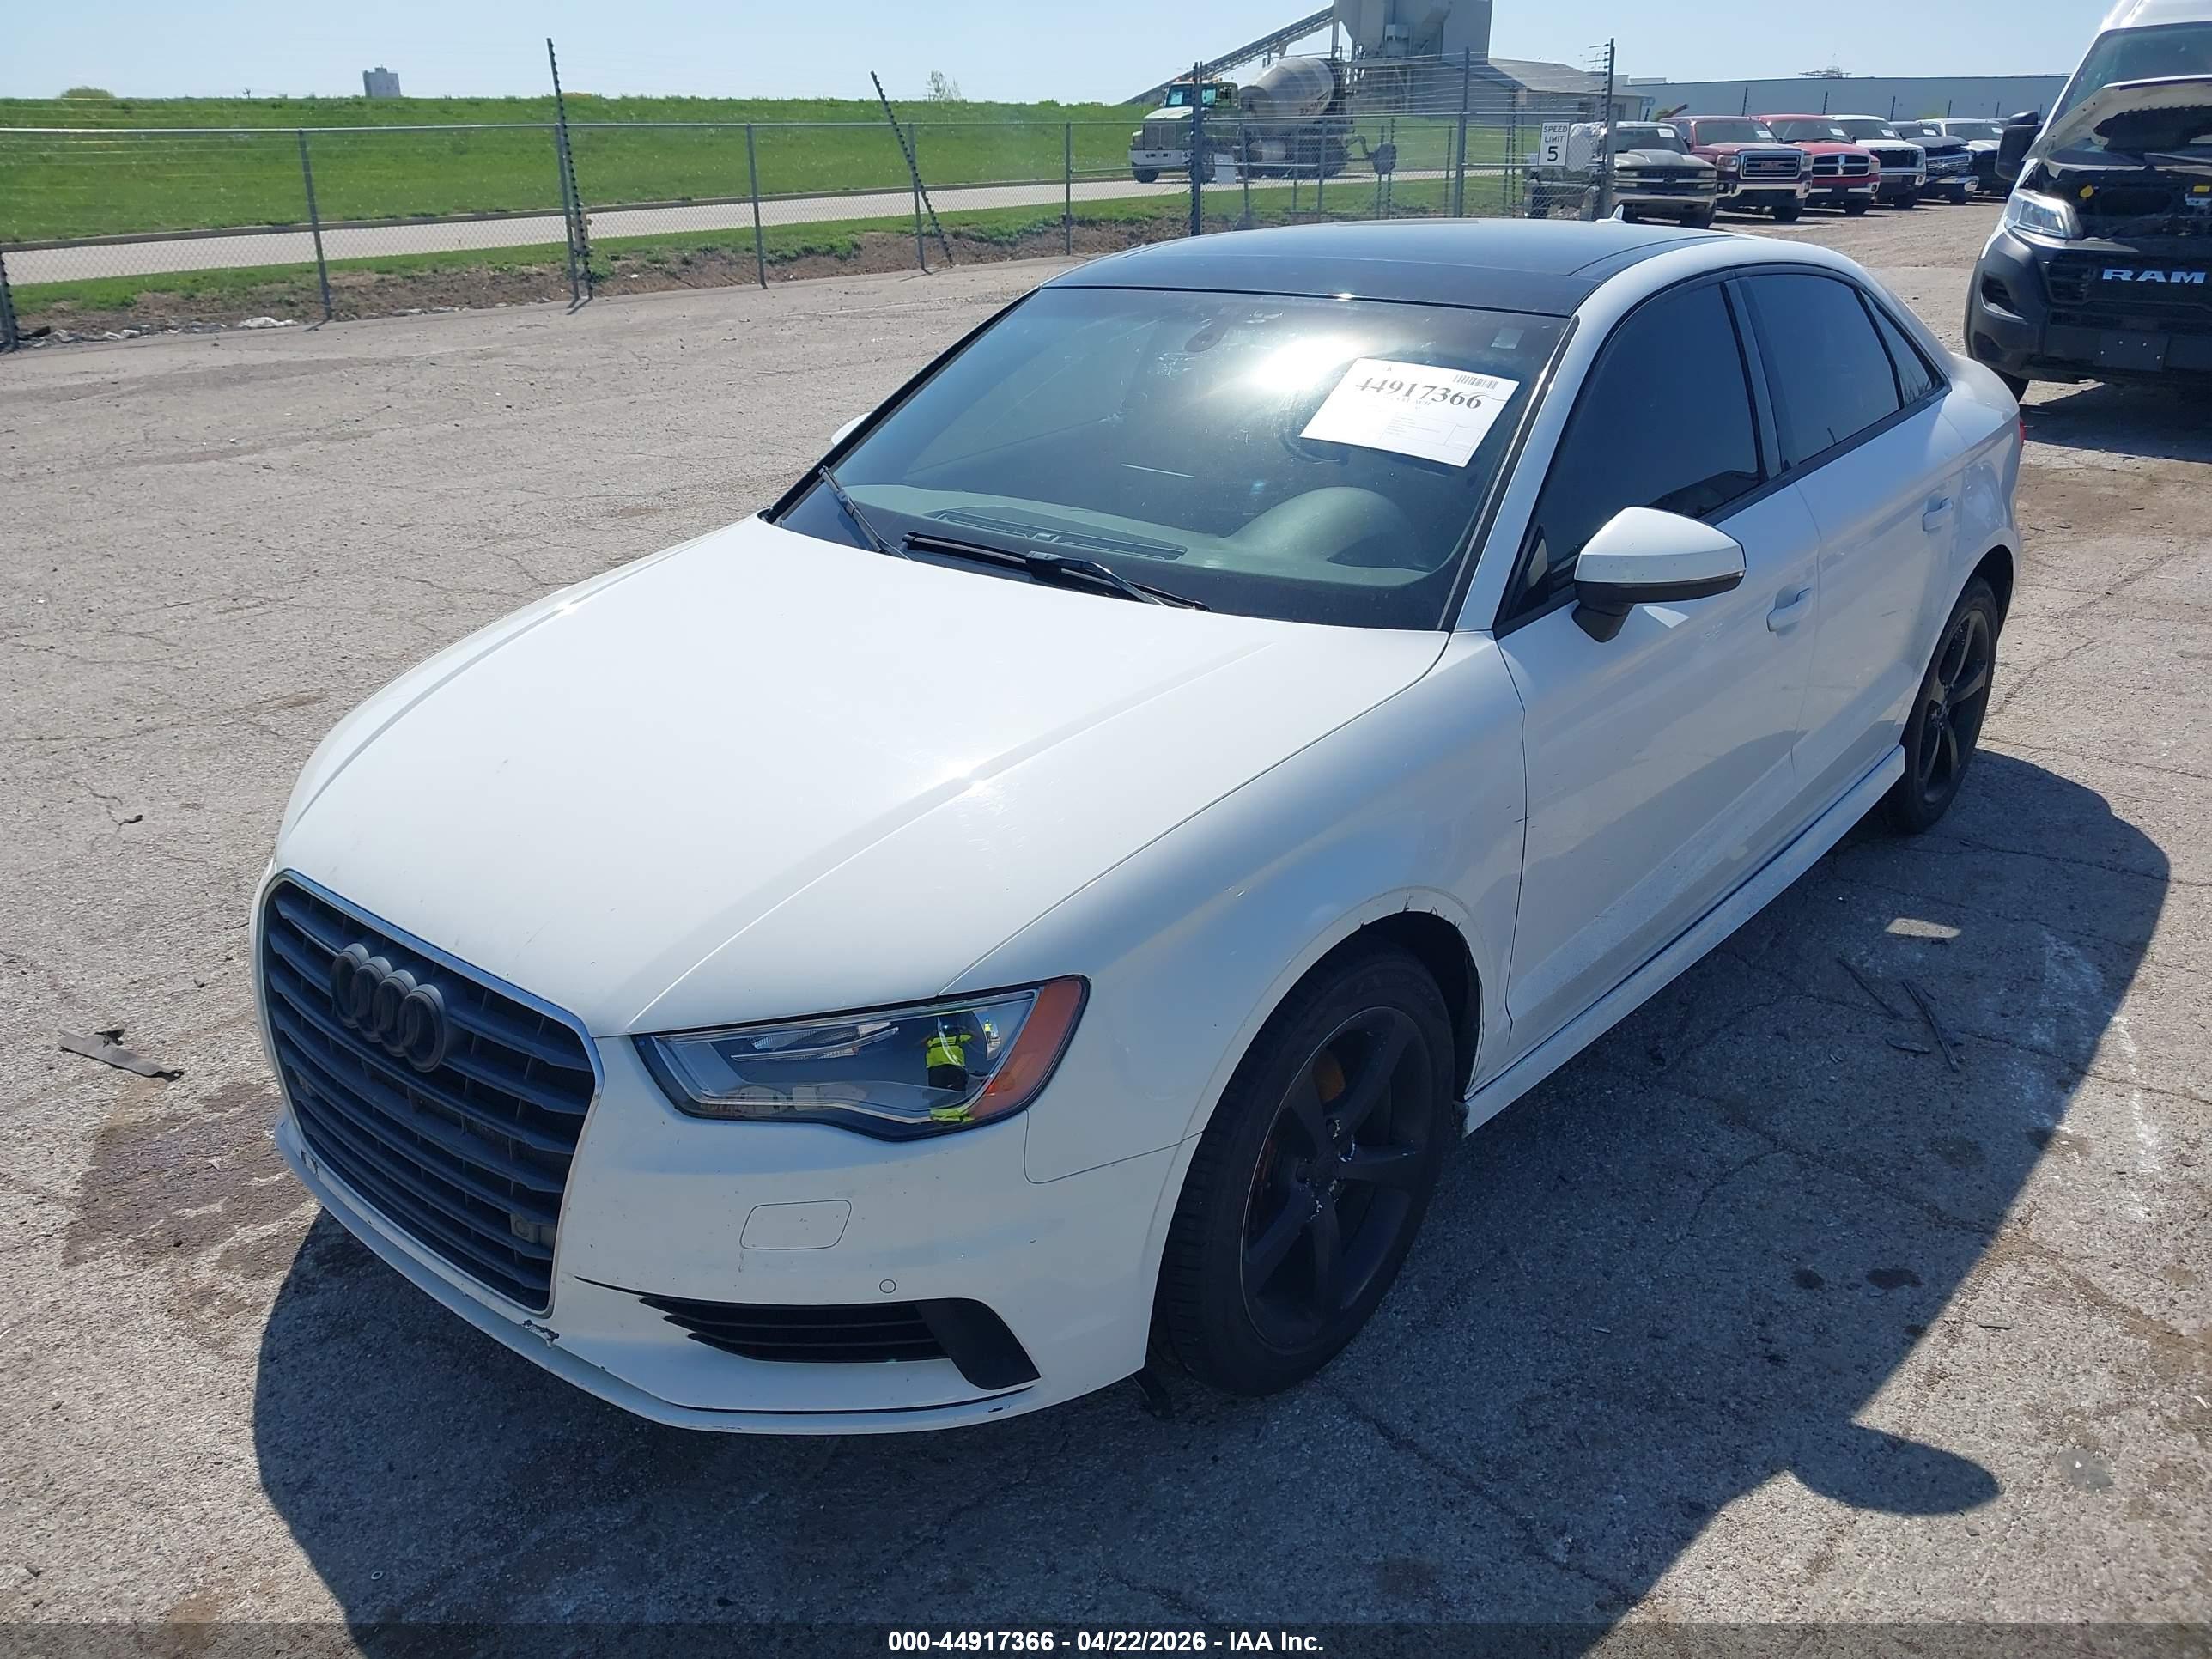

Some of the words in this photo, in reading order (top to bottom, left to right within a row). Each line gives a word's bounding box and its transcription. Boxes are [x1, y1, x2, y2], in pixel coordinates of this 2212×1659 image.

[1547, 146, 1559, 162] 5
[2102, 269, 2206, 283] RAM
[1355, 377, 1483, 410] 44917366
